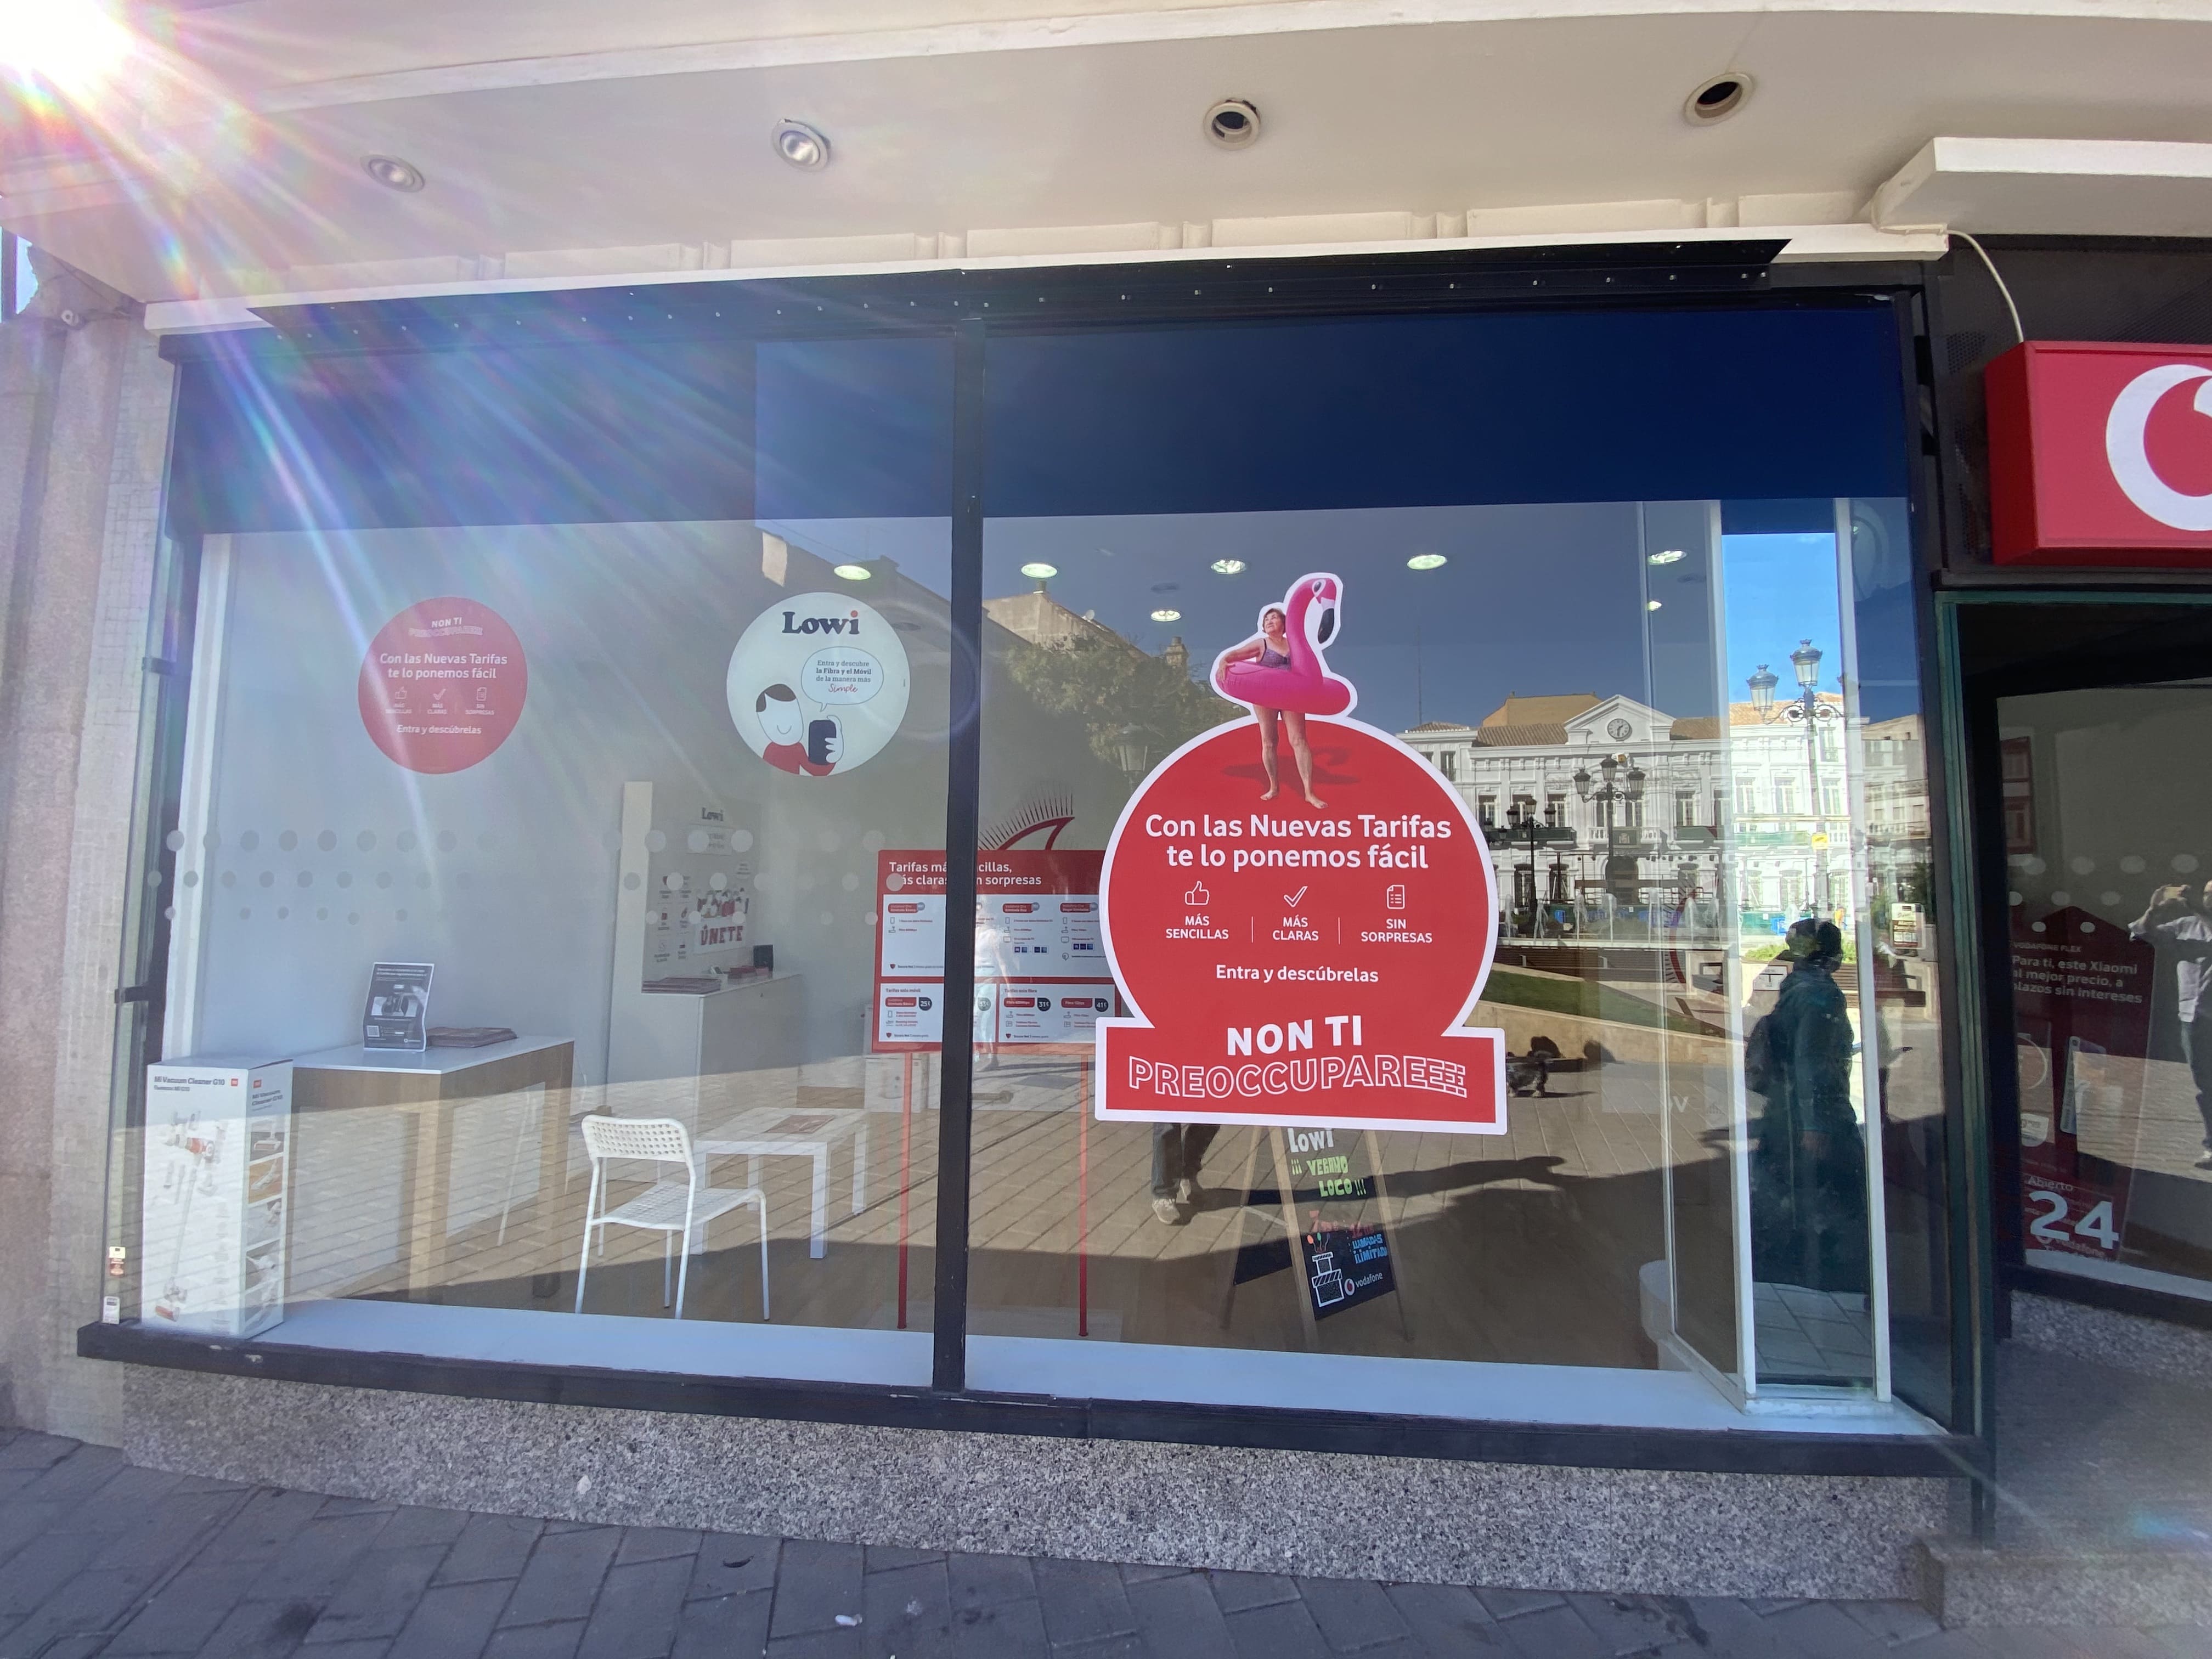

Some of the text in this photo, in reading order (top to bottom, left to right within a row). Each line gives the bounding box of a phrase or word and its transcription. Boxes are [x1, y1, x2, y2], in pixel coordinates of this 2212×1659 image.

[432, 618, 451, 628] NON
[782, 610, 860, 635] Lowi
[380, 653, 507, 665] Con las Nuevas Tarifas
[388, 667, 496, 680] te lo ponemos fácil
[828, 684, 858, 693] Simple
[397, 724, 482, 735] Entra y descúbrelas
[1146, 814, 1452, 839] Con las Nuevas Tarifas
[1167, 843, 1429, 872] te lo ponemos fácil
[889, 861, 928, 872] Tarifas
[931, 861, 947, 872] má
[985, 877, 1042, 888] sorpresas
[1184, 913, 1210, 926] MÁS
[1282, 915, 1308, 928] MÁS
[1385, 918, 1407, 930] SIN
[700, 924, 743, 946] ÚNETE
[1165, 928, 1229, 940] SENCILLAS
[1272, 929, 1319, 941] CLARAS
[1361, 932, 1433, 944] SORPRESAS
[2060, 945, 2082, 953] FLEX
[2012, 955, 2138, 974] Para ti, este Xiaomi
[1216, 964, 1379, 984] Entra y descúbrelas
[2025, 970, 2064, 983] mejor
[2067, 974, 2112, 988] precio,
[2115, 979, 2124, 988] a
[2055, 985, 2075, 996] sin
[2078, 988, 2143, 1004] intereses
[1227, 1015, 1362, 1057] NON TI
[1318, 1178, 1353, 1197] LOCO
[2028, 1176, 2074, 1192] Abierto
[2029, 1190, 2120, 1250] 24
[1356, 1272, 1384, 1288] vodafone
